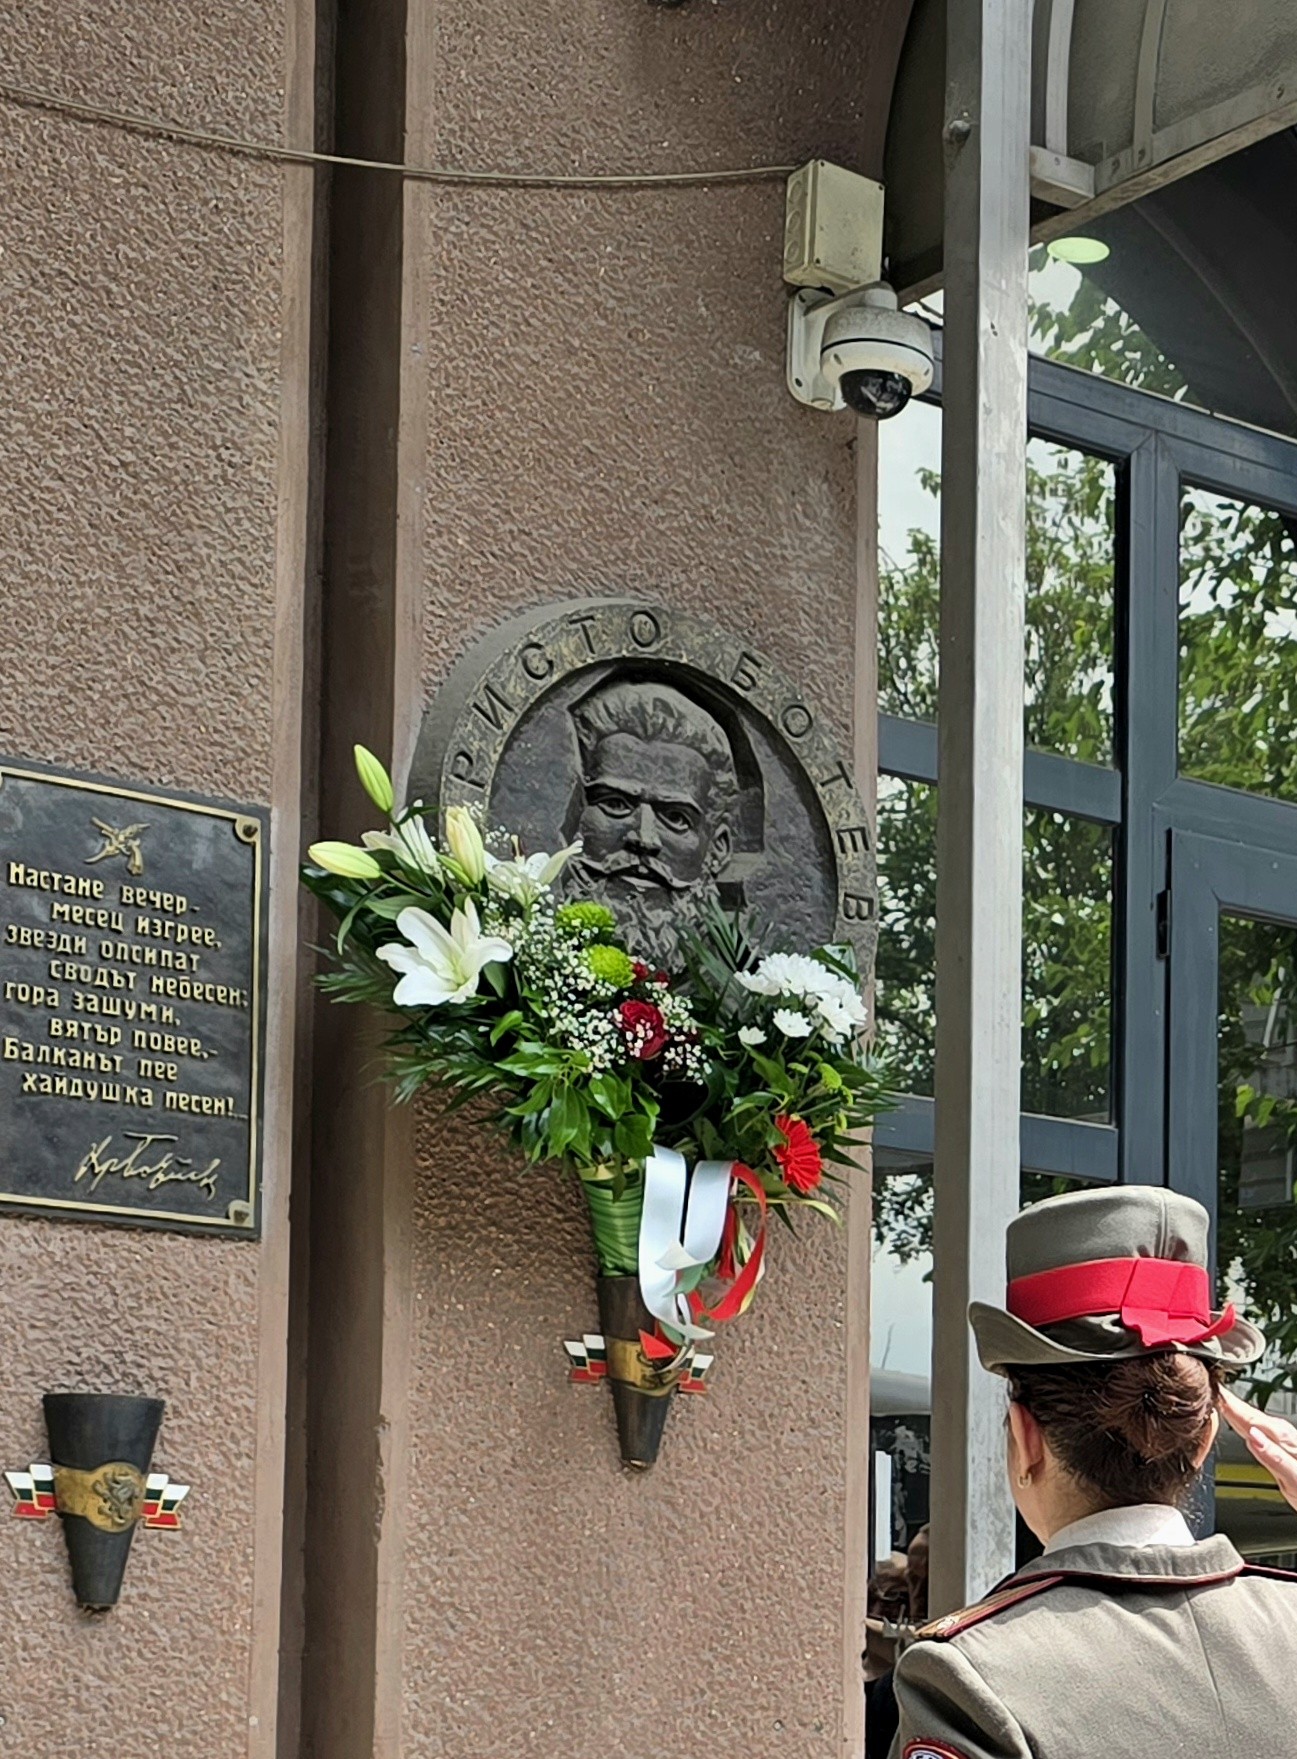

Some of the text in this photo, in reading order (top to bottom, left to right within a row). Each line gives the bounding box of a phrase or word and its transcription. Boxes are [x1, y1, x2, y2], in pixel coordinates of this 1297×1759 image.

[449, 609, 874, 921] РИСТО БОТЕВ
[9, 862, 105, 899] Настане
[51, 902, 222, 948] месец изгрее,
[6, 924, 200, 972] звезди опсипат
[49, 960, 137, 990] сводът
[5, 982, 181, 1026] гора зашуми,
[50, 1017, 122, 1045] вятър
[4, 1036, 178, 1081] Балканът пее
[22, 1071, 154, 1107] хайдушка
